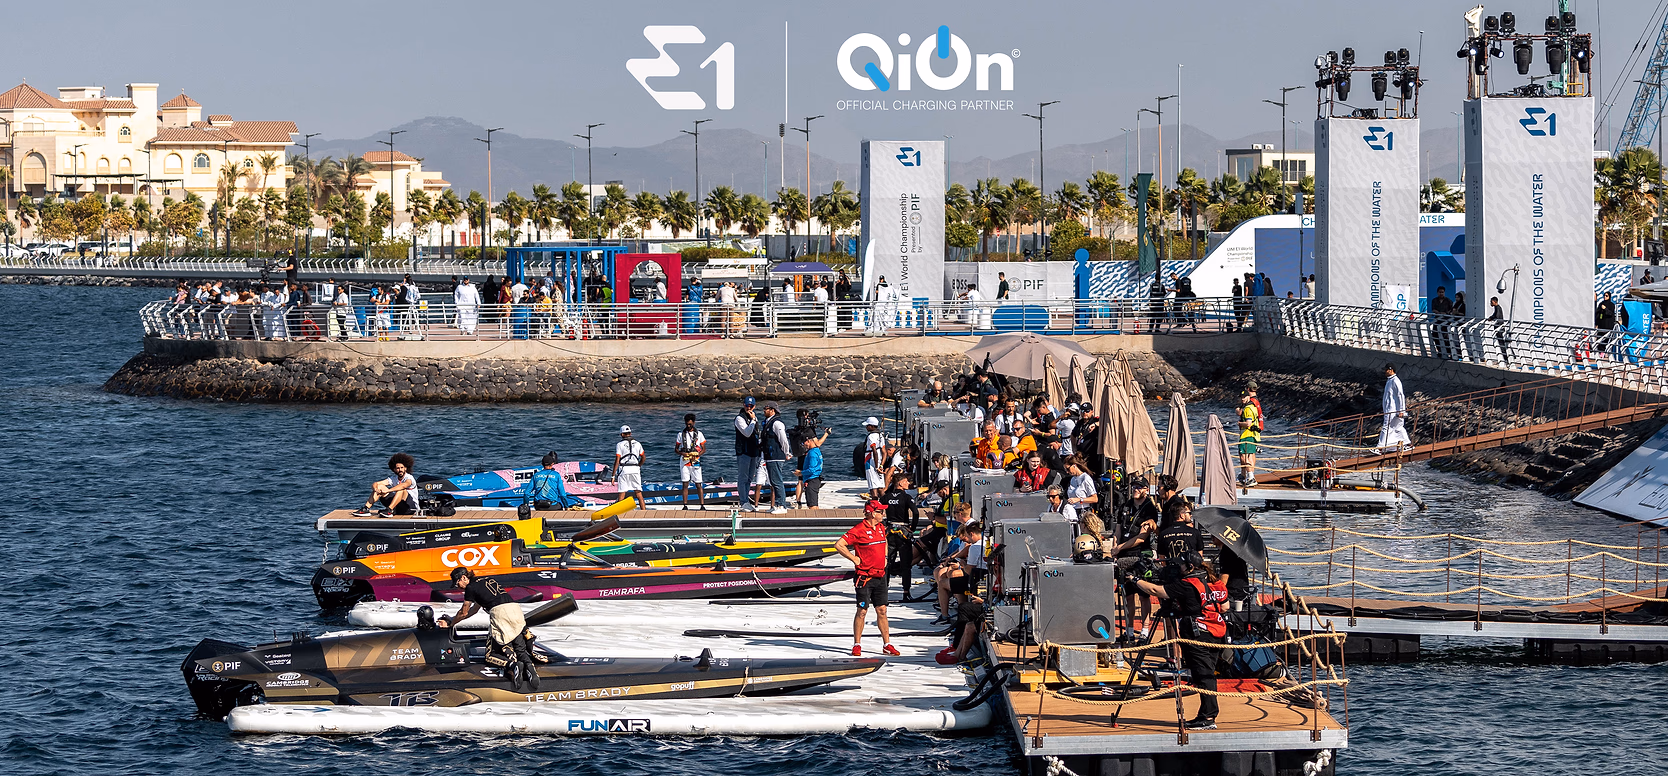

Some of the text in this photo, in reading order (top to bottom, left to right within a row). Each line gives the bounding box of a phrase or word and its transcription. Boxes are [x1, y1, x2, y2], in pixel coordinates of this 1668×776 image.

[911, 193, 920, 211] PIF
[1533, 173, 1544, 218] WATER
[900, 192, 909, 253] Championship
[1420, 215, 1445, 224] ATER
[1533, 221, 1544, 246] THE
[1371, 180, 1381, 309] AMPIONS OF THE WATER
[1533, 248, 1544, 266] OF
[901, 255, 909, 279] World
[1023, 280, 1044, 289] PIF
[1642, 313, 1650, 335] ATER
[1077, 541, 1086, 550] 12
[441, 545, 500, 567] COX
[1043, 569, 1064, 578] QiOn
[224, 662, 241, 670] PIF
[670, 681, 695, 690] gopuff
[526, 687, 631, 703] TEAM BRADY
[568, 719, 650, 733] FUNAIR
